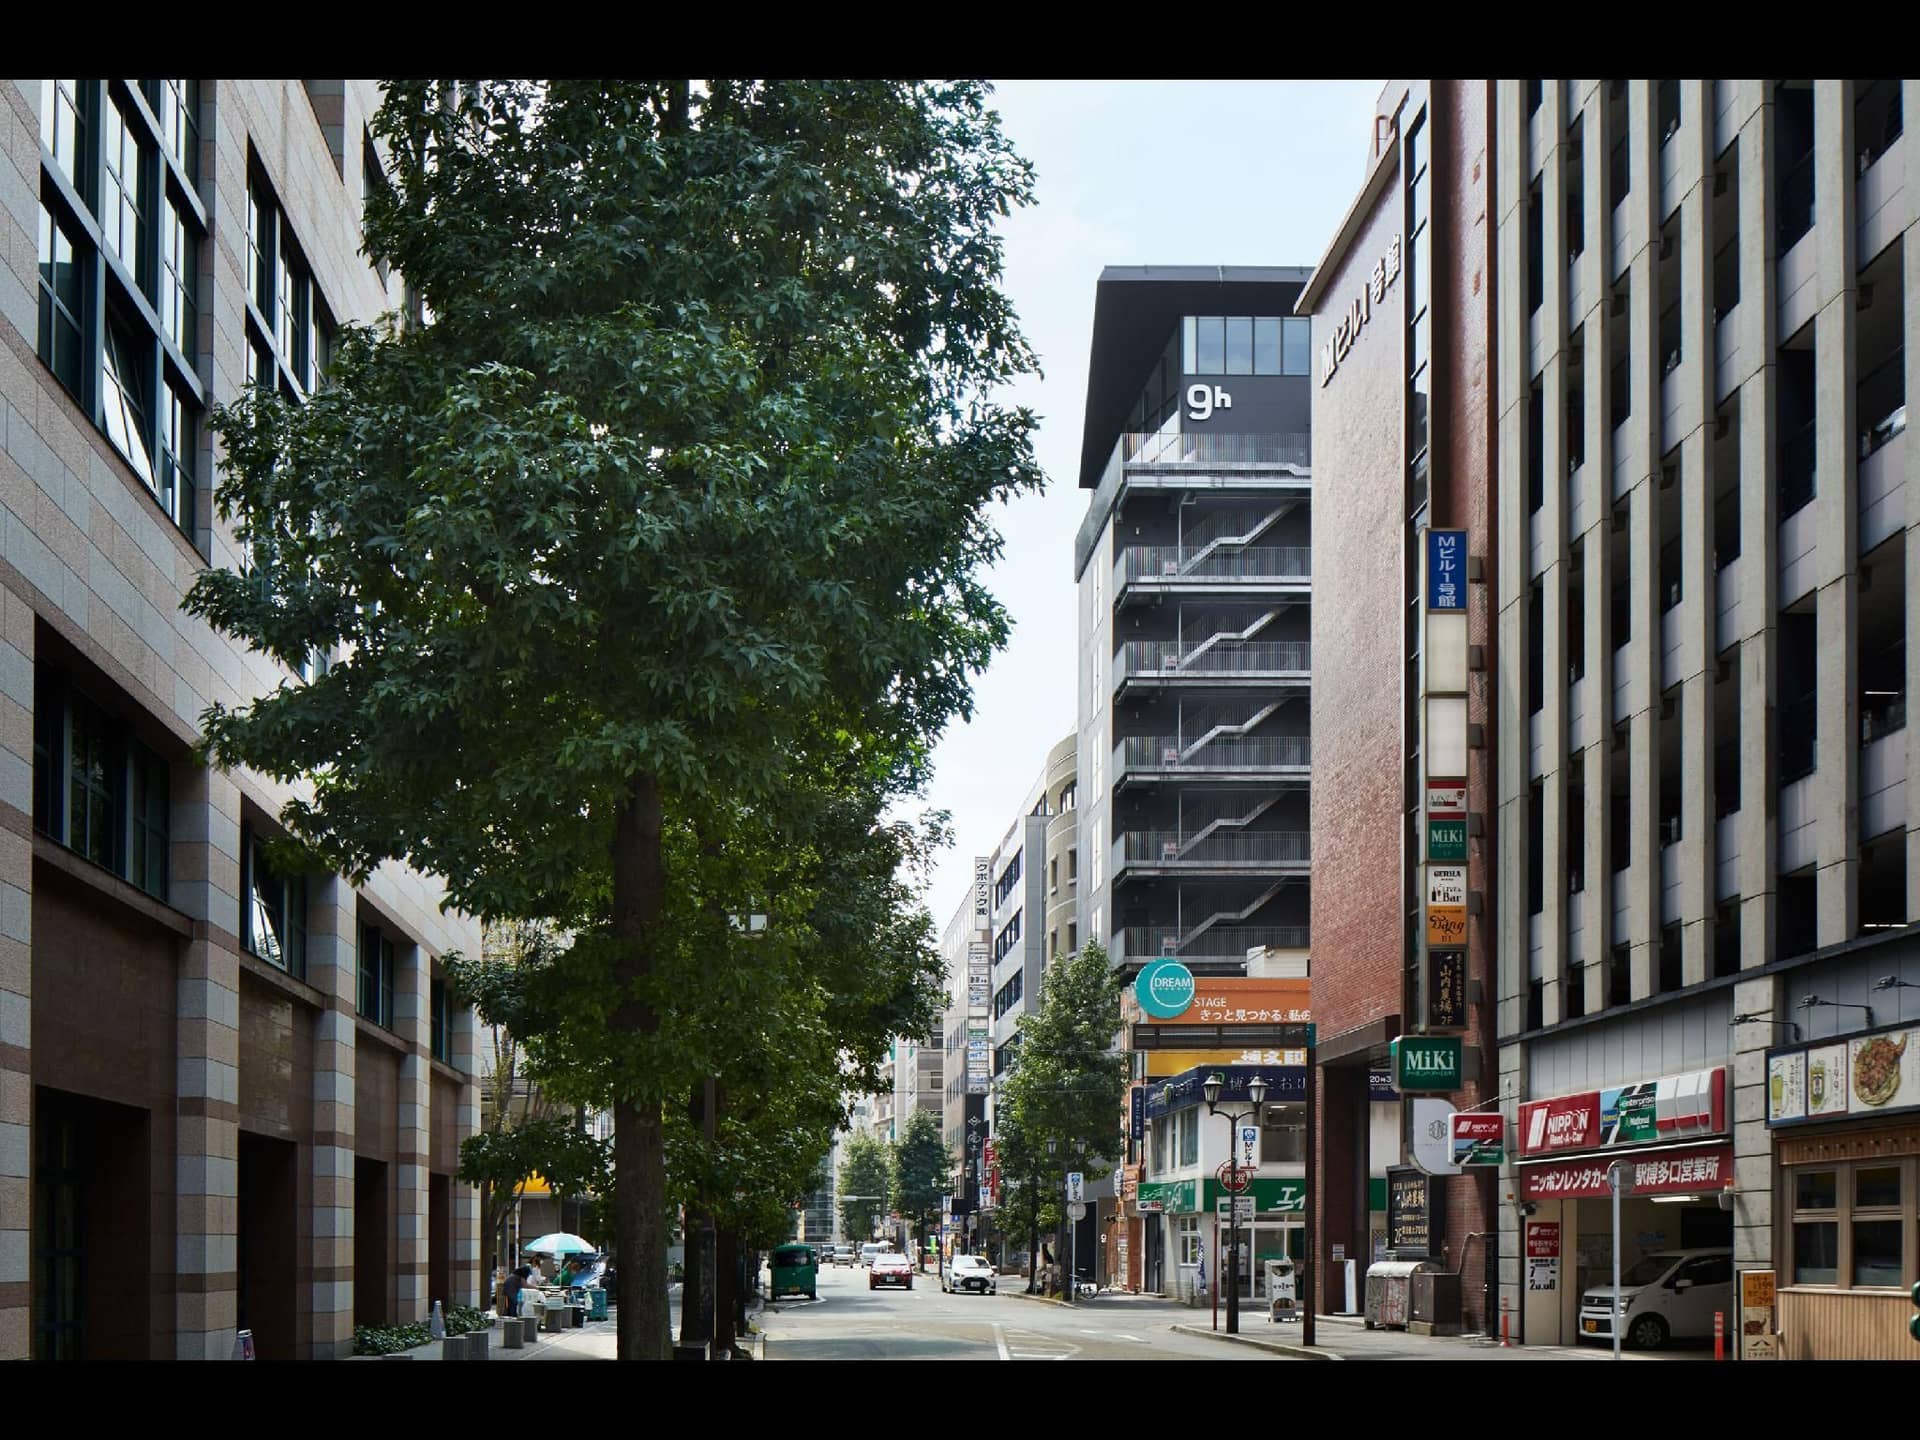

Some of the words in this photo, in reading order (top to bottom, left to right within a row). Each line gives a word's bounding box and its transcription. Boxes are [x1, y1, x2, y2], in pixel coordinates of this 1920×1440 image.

[1187, 384, 1232, 420] 9h
[1438, 535, 1456, 608] Mビル1号館
[1431, 829, 1464, 843] MiKi
[1154, 977, 1191, 988] DREAM
[1193, 998, 1227, 1008] STAGE
[1406, 1050, 1455, 1070] MiKi
[1547, 1110, 1589, 1135] NIPPON
